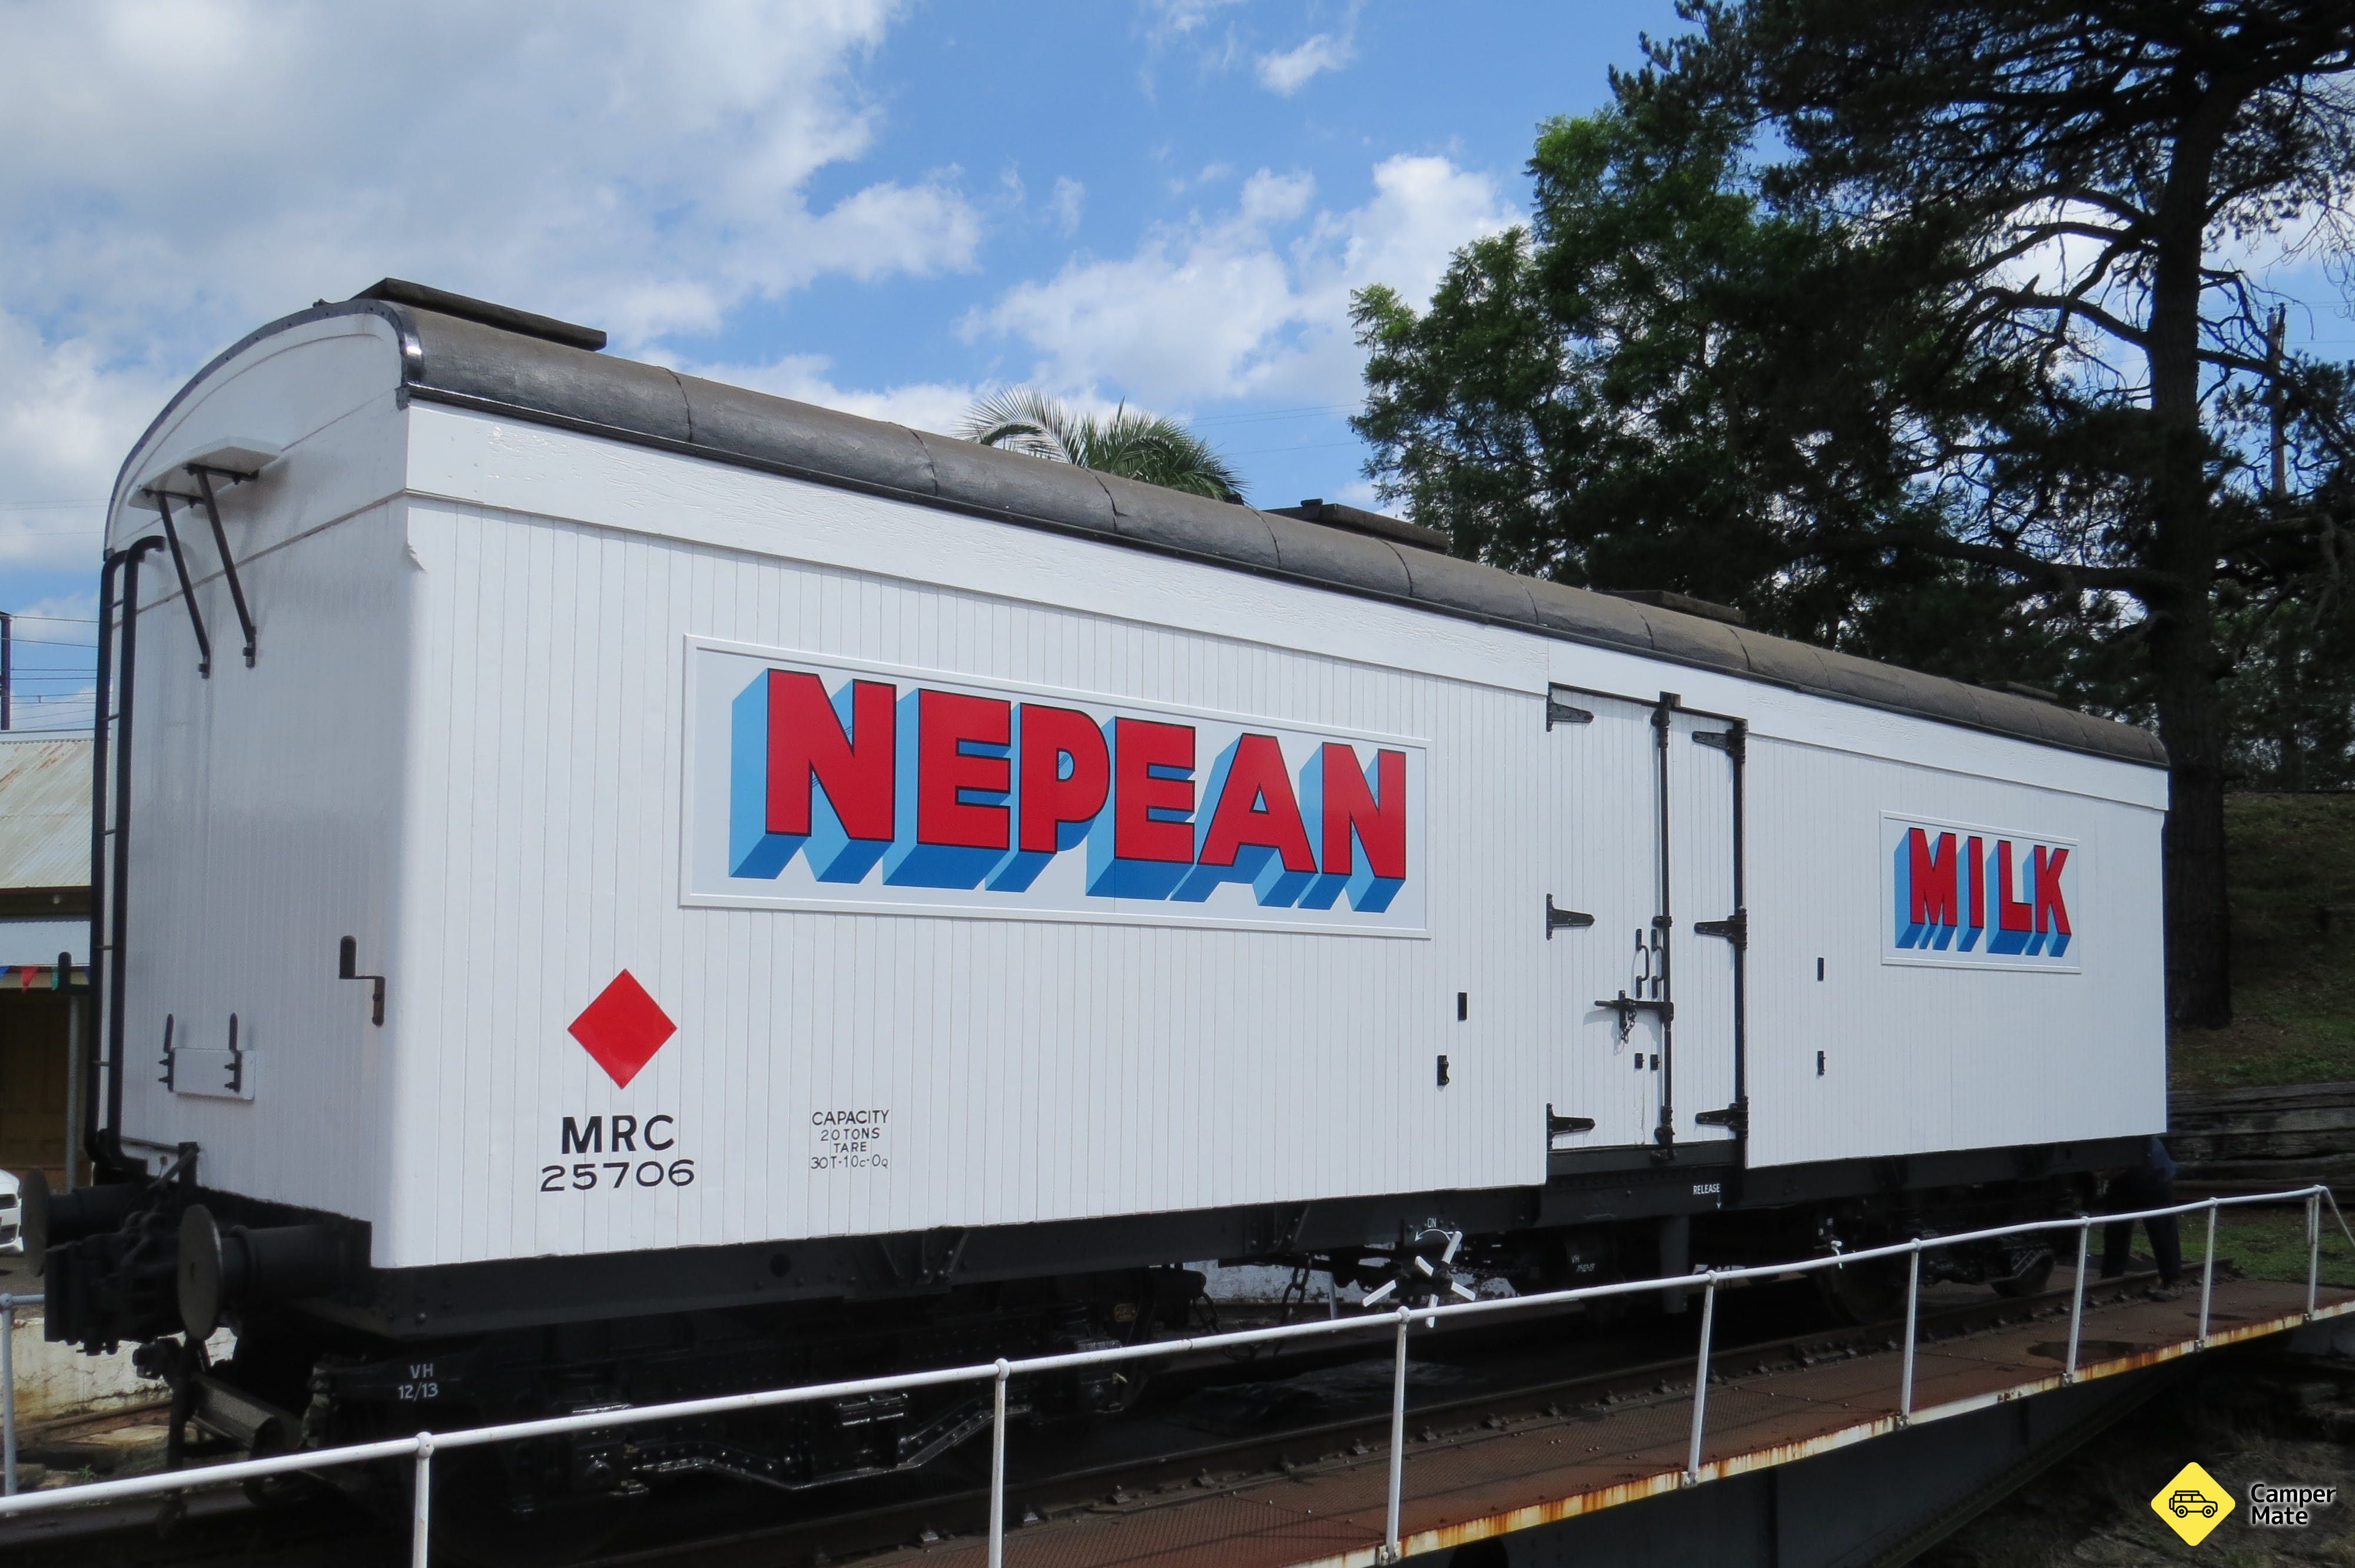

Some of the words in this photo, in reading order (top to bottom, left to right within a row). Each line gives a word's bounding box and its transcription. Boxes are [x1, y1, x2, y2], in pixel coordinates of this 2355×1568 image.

[729, 667, 1407, 913] NEPEAN
[1893, 826, 2072, 958] MILK
[811, 1109, 890, 1126] CAPACITY
[561, 1114, 675, 1155] MRC
[820, 1129, 840, 1142] 20
[843, 1127, 880, 1140] TONS
[833, 1141, 867, 1154] TARE
[540, 1158, 695, 1192] 25706
[1693, 1183, 1720, 1195] RELEASE
[1427, 1217, 1437, 1228] ON
[409, 1363, 433, 1378] VH
[398, 1381, 439, 1402] 12/13
